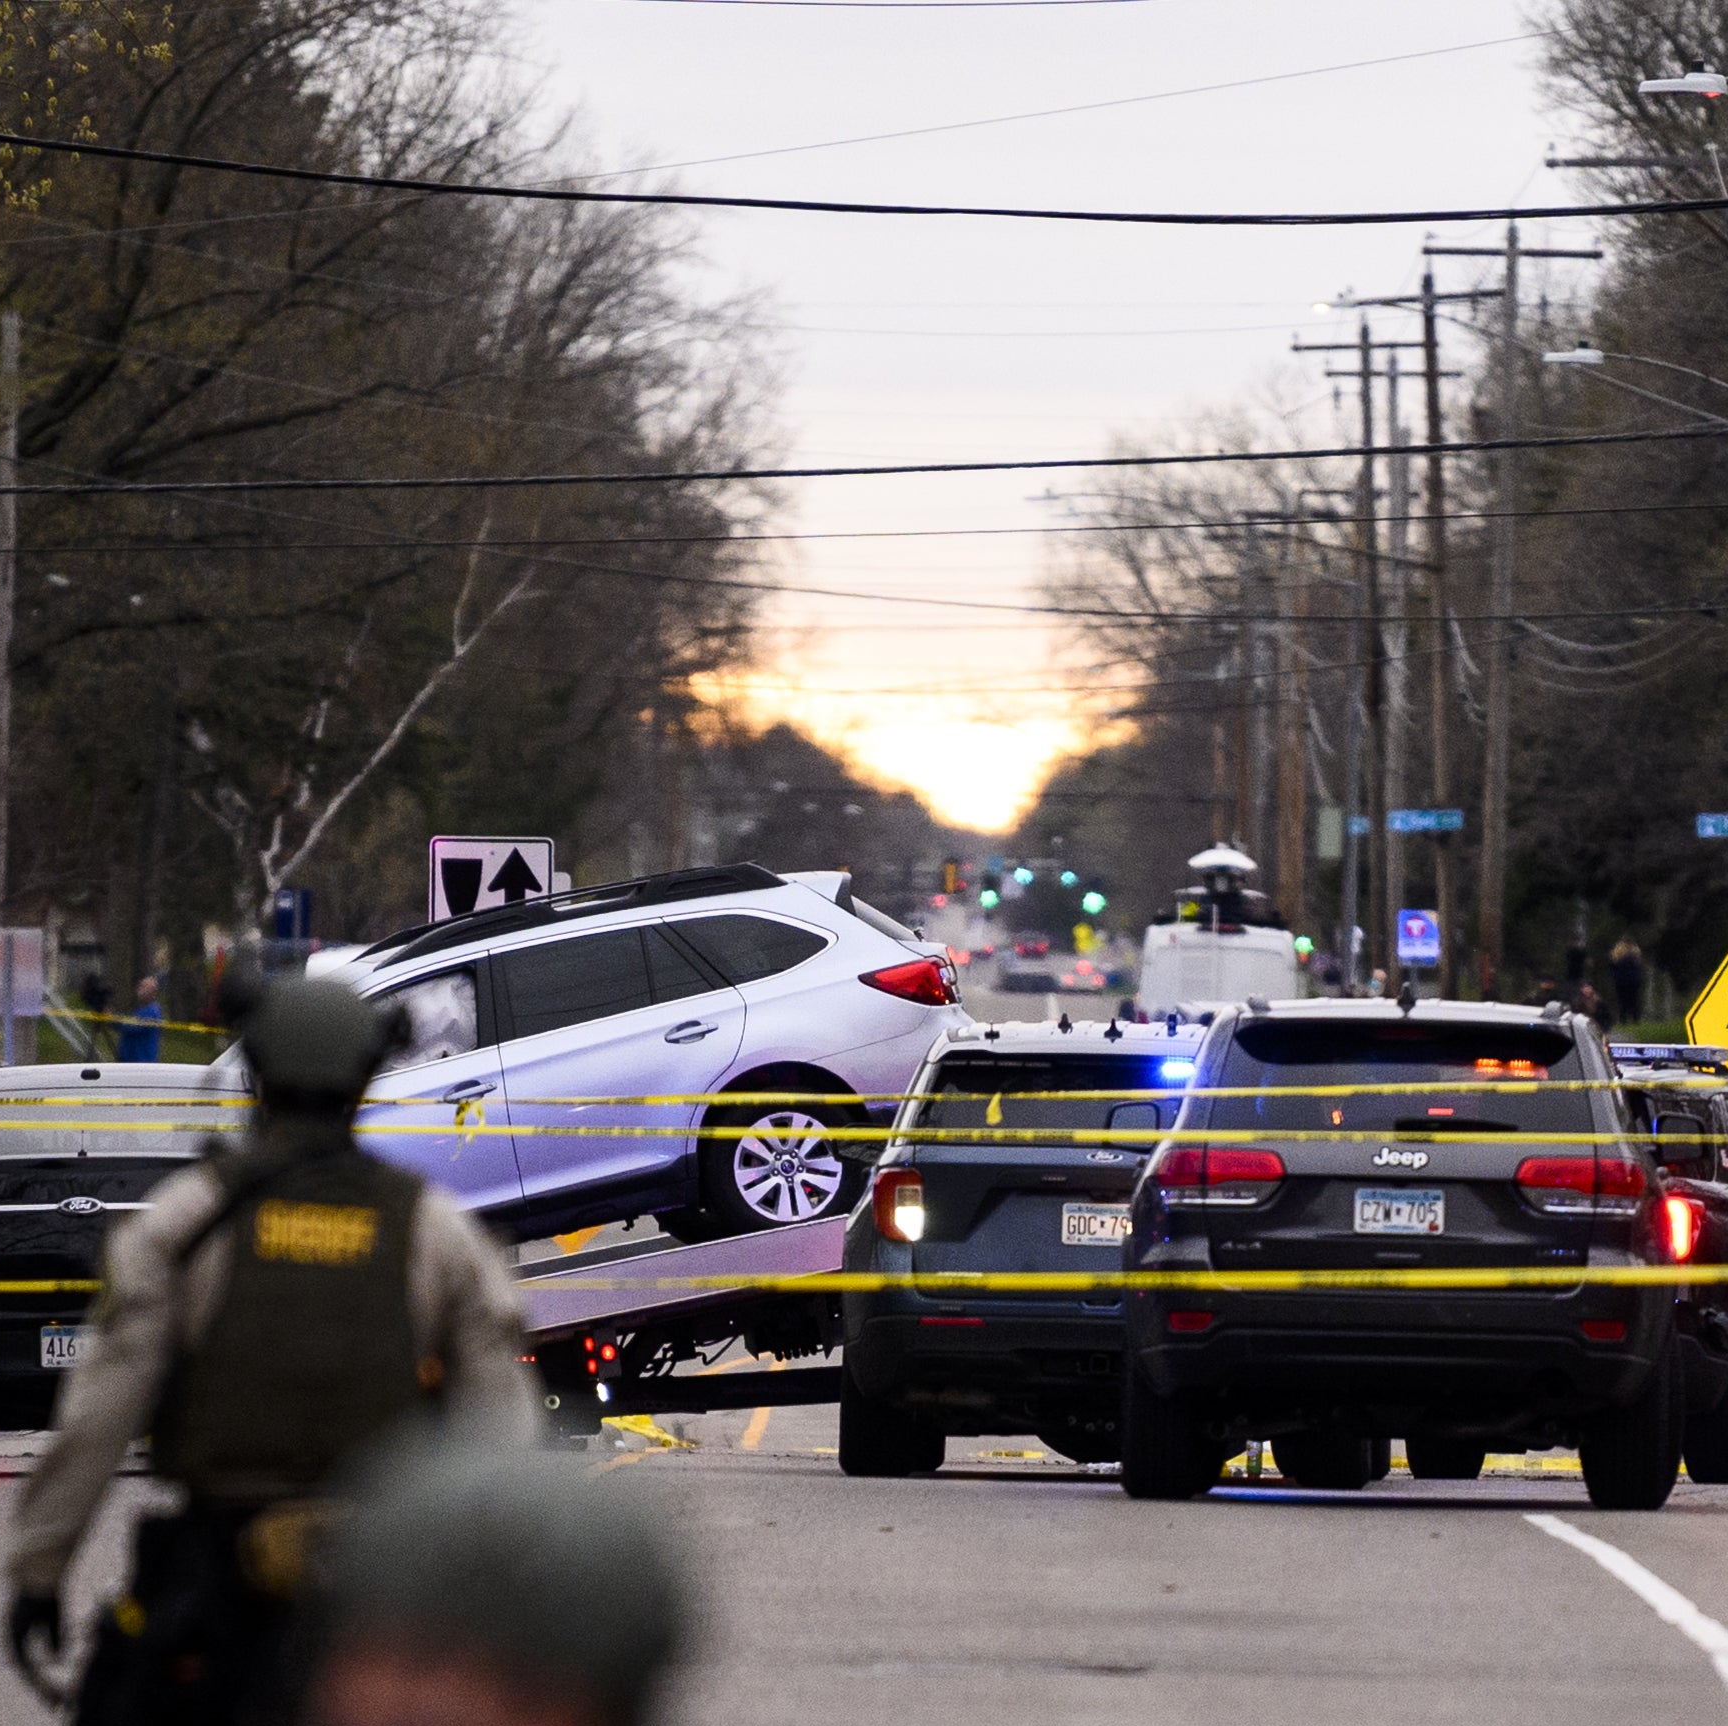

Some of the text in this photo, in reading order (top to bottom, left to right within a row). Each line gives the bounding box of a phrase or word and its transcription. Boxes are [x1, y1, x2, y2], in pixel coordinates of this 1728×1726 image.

[1373, 1148, 1428, 1169] Jeep
[1067, 1215, 1097, 1236] GDC
[46, 1337, 76, 1358] 416
